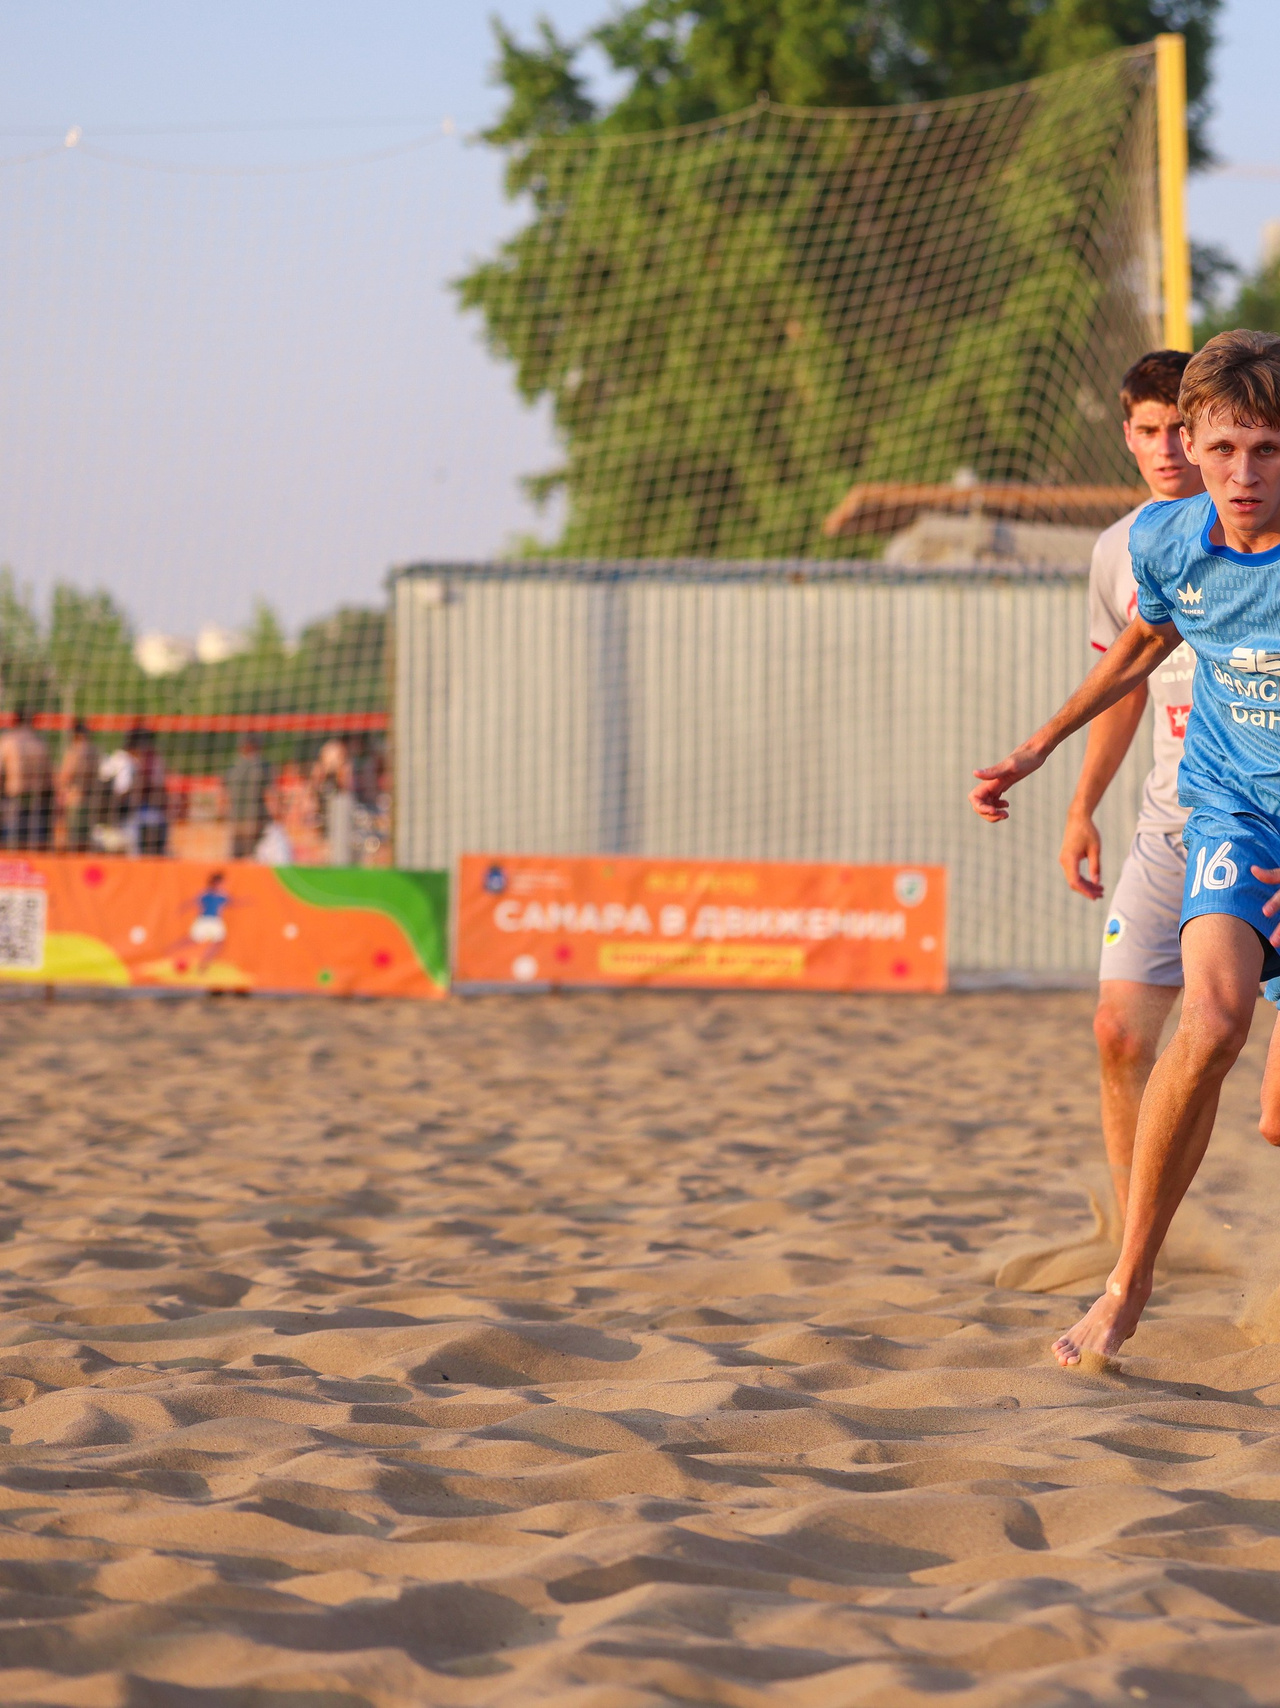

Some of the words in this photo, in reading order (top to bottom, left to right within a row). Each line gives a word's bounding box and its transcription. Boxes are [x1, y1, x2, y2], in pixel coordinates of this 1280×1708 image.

[1190, 841, 1238, 898] 16
[493, 900, 653, 934] САМАРА
[659, 904, 687, 937] В
